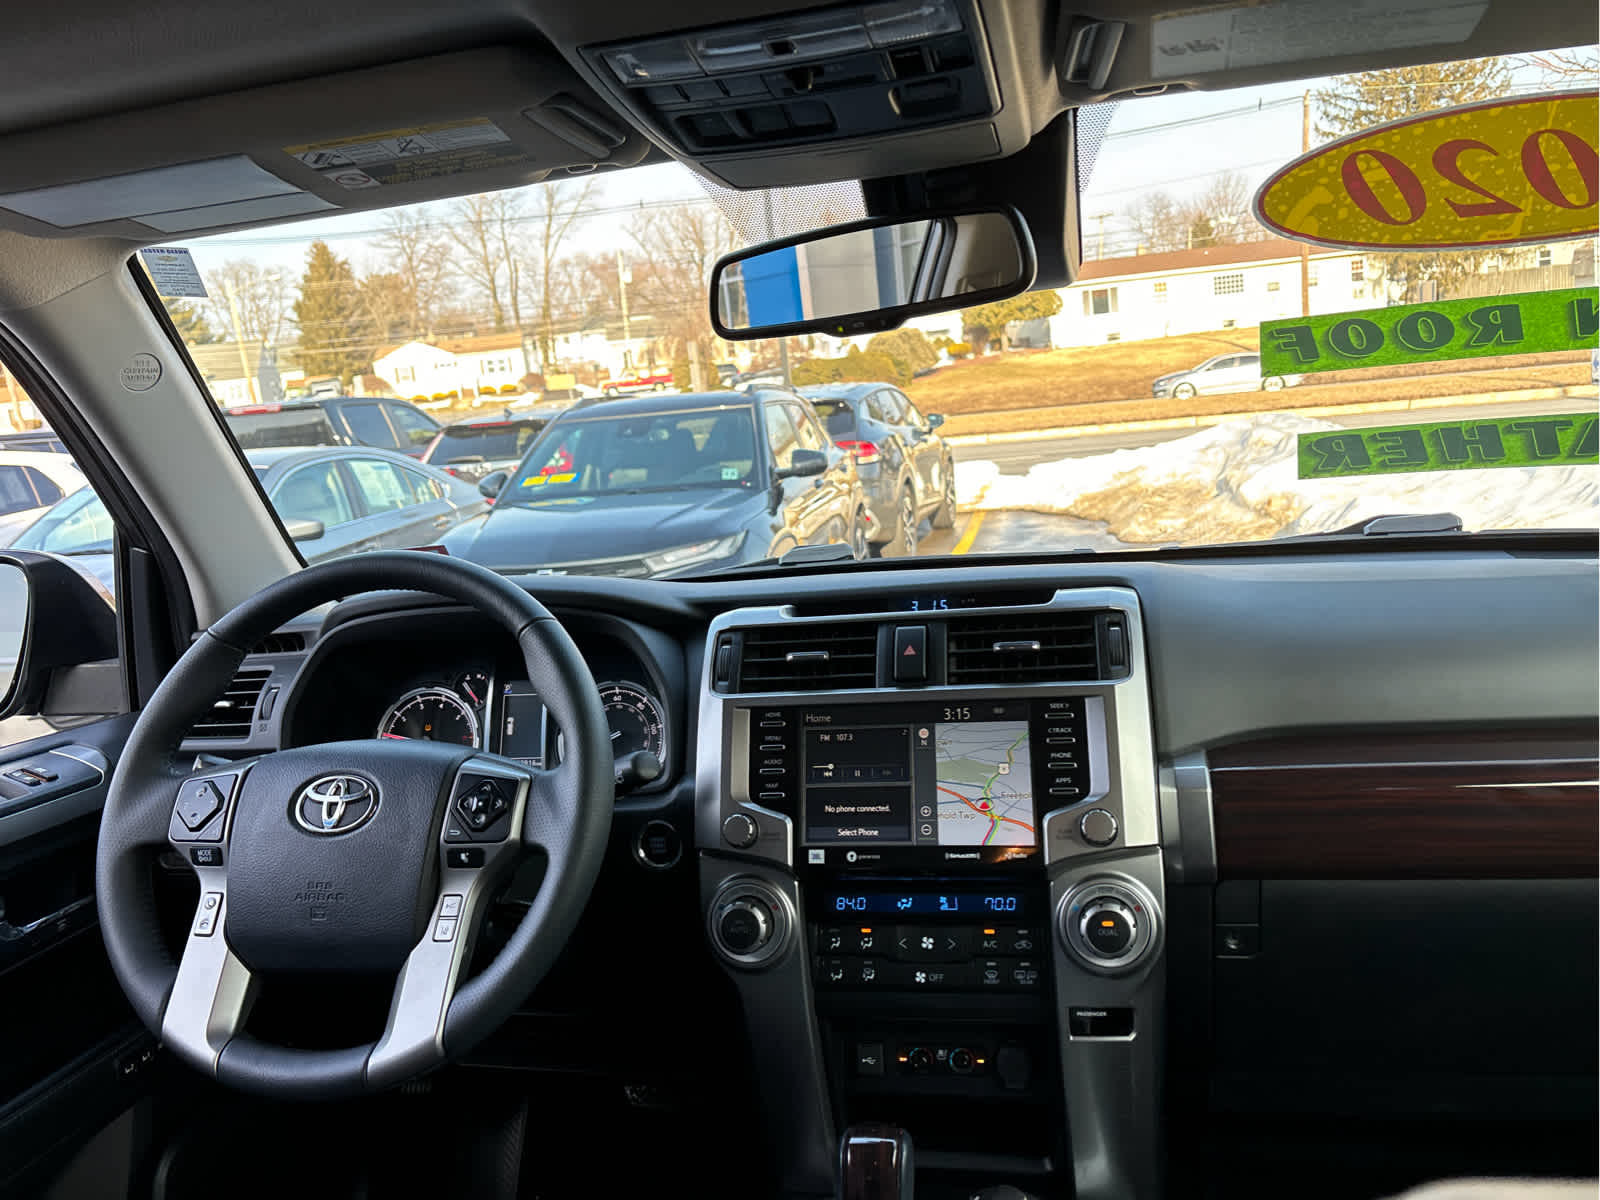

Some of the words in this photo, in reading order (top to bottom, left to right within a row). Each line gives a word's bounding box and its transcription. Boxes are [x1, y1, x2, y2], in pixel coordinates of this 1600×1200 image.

[805, 713, 832, 723] Home
[943, 707, 971, 721] 3:15
[819, 734, 830, 742] FM
[824, 805, 836, 813] No
[836, 804, 856, 814] phone
[857, 804, 891, 813] connected.
[957, 811, 977, 821] Twp
[837, 827, 857, 837] Select
[857, 827, 879, 837] Phone
[294, 892, 345, 901] AIRBAG
[835, 896, 867, 911] 84.0
[984, 897, 1017, 911] 70.0
[983, 940, 998, 949] A/C
[928, 973, 945, 982] OFF
